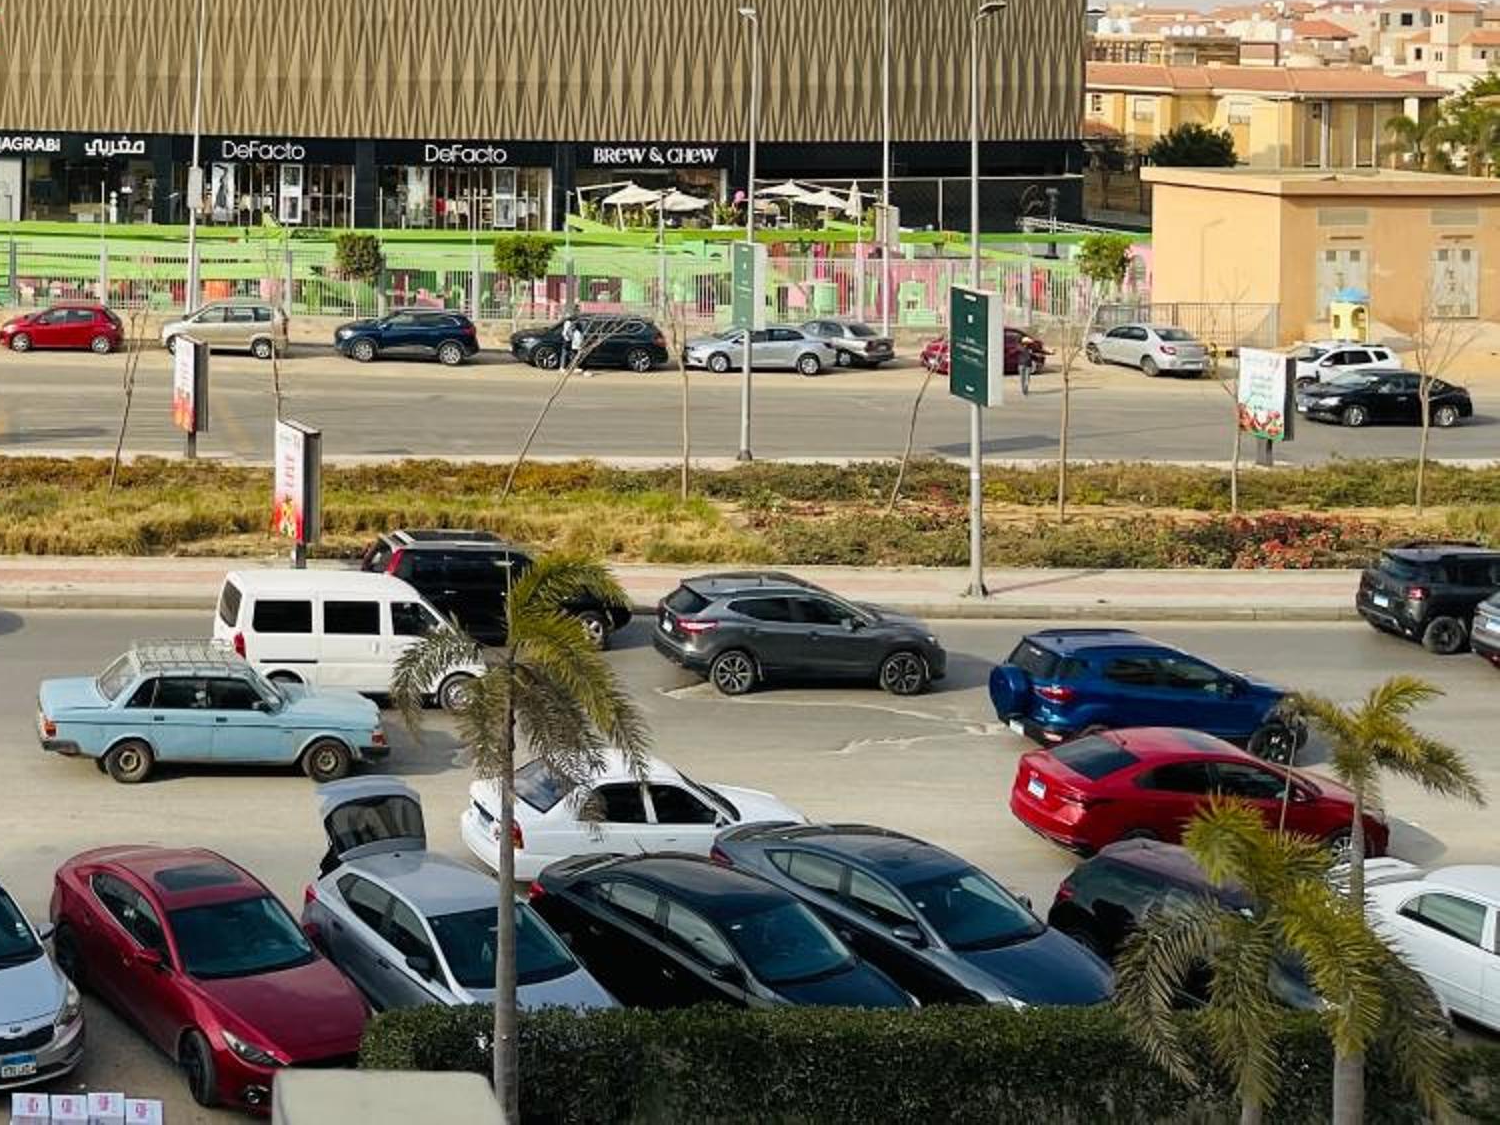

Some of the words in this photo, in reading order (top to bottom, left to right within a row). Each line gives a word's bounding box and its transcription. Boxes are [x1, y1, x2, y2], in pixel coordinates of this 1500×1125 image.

[84, 135, 145, 156] مغربي
[221, 140, 306, 160] DeFacto
[425, 144, 507, 164] DeFacto
[649, 146, 665, 165] &
